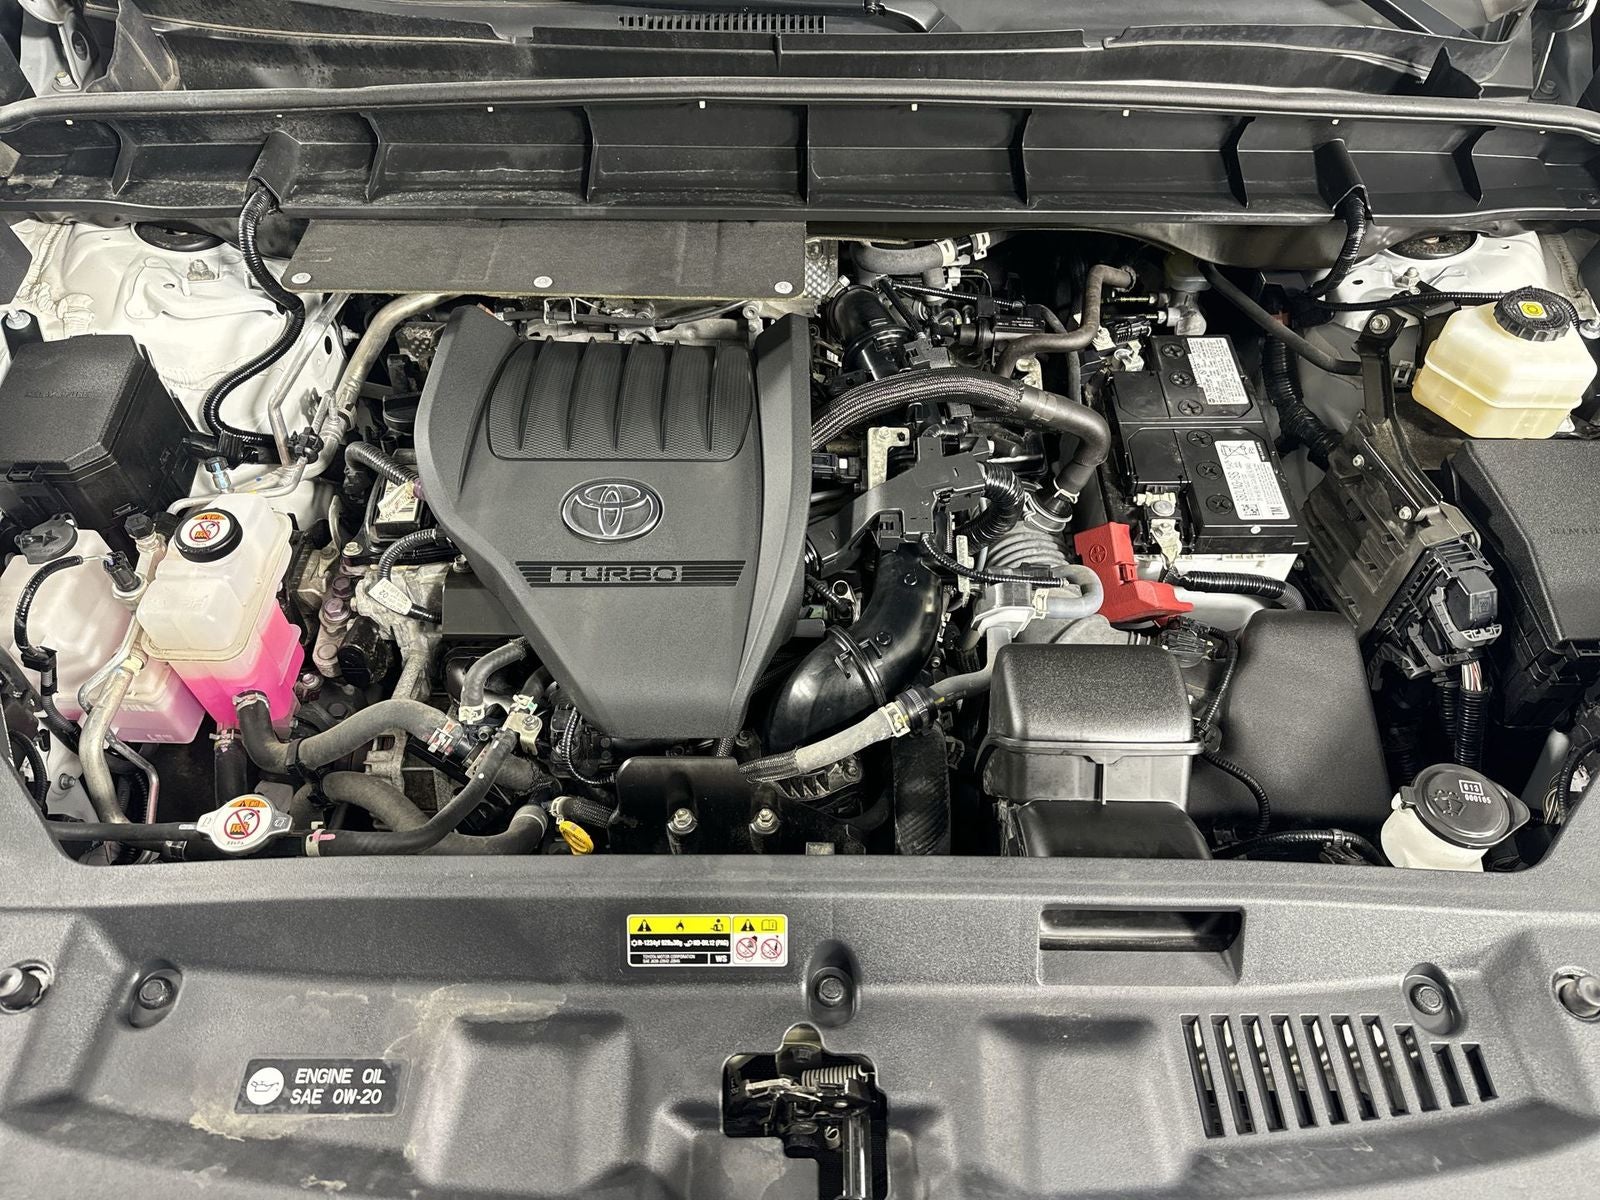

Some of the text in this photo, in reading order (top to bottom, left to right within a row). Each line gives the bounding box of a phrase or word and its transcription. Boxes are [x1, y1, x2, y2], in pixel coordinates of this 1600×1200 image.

[555, 566, 678, 583] TURBO
[294, 1067, 387, 1084] ENGINE OIL
[289, 1089, 383, 1105] SAE 0W-20
